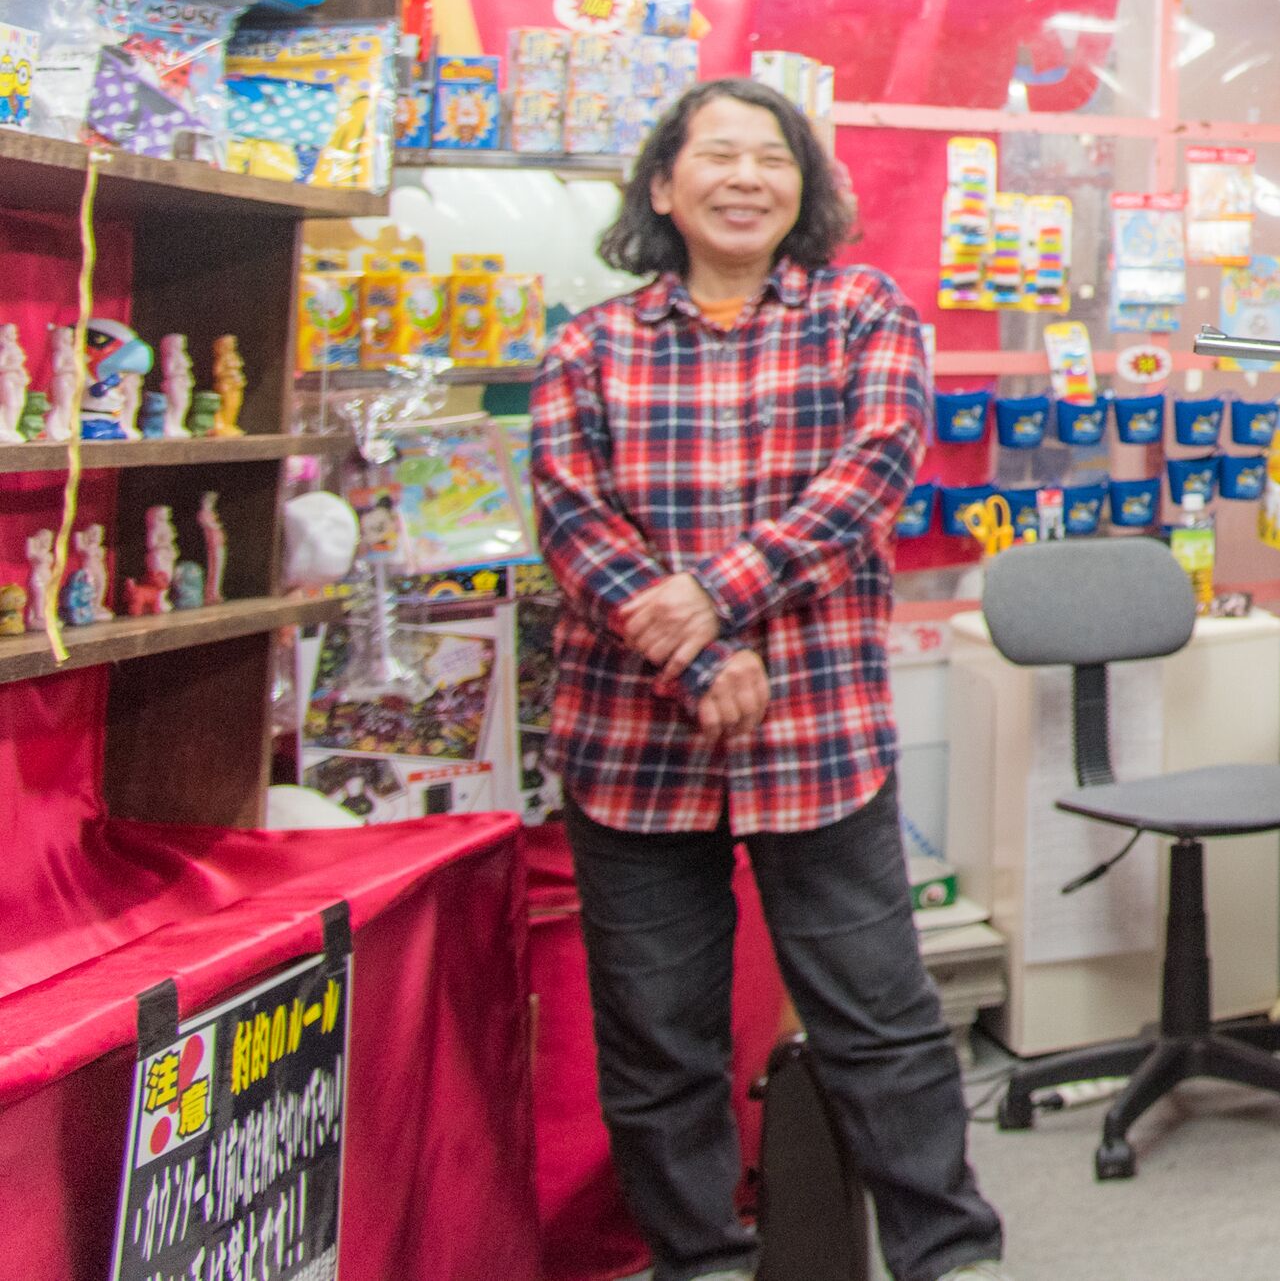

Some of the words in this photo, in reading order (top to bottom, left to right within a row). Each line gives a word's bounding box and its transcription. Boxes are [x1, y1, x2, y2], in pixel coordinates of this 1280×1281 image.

[231, 978, 341, 1096] 射的のルール
[145, 1049, 209, 1138] 注意
